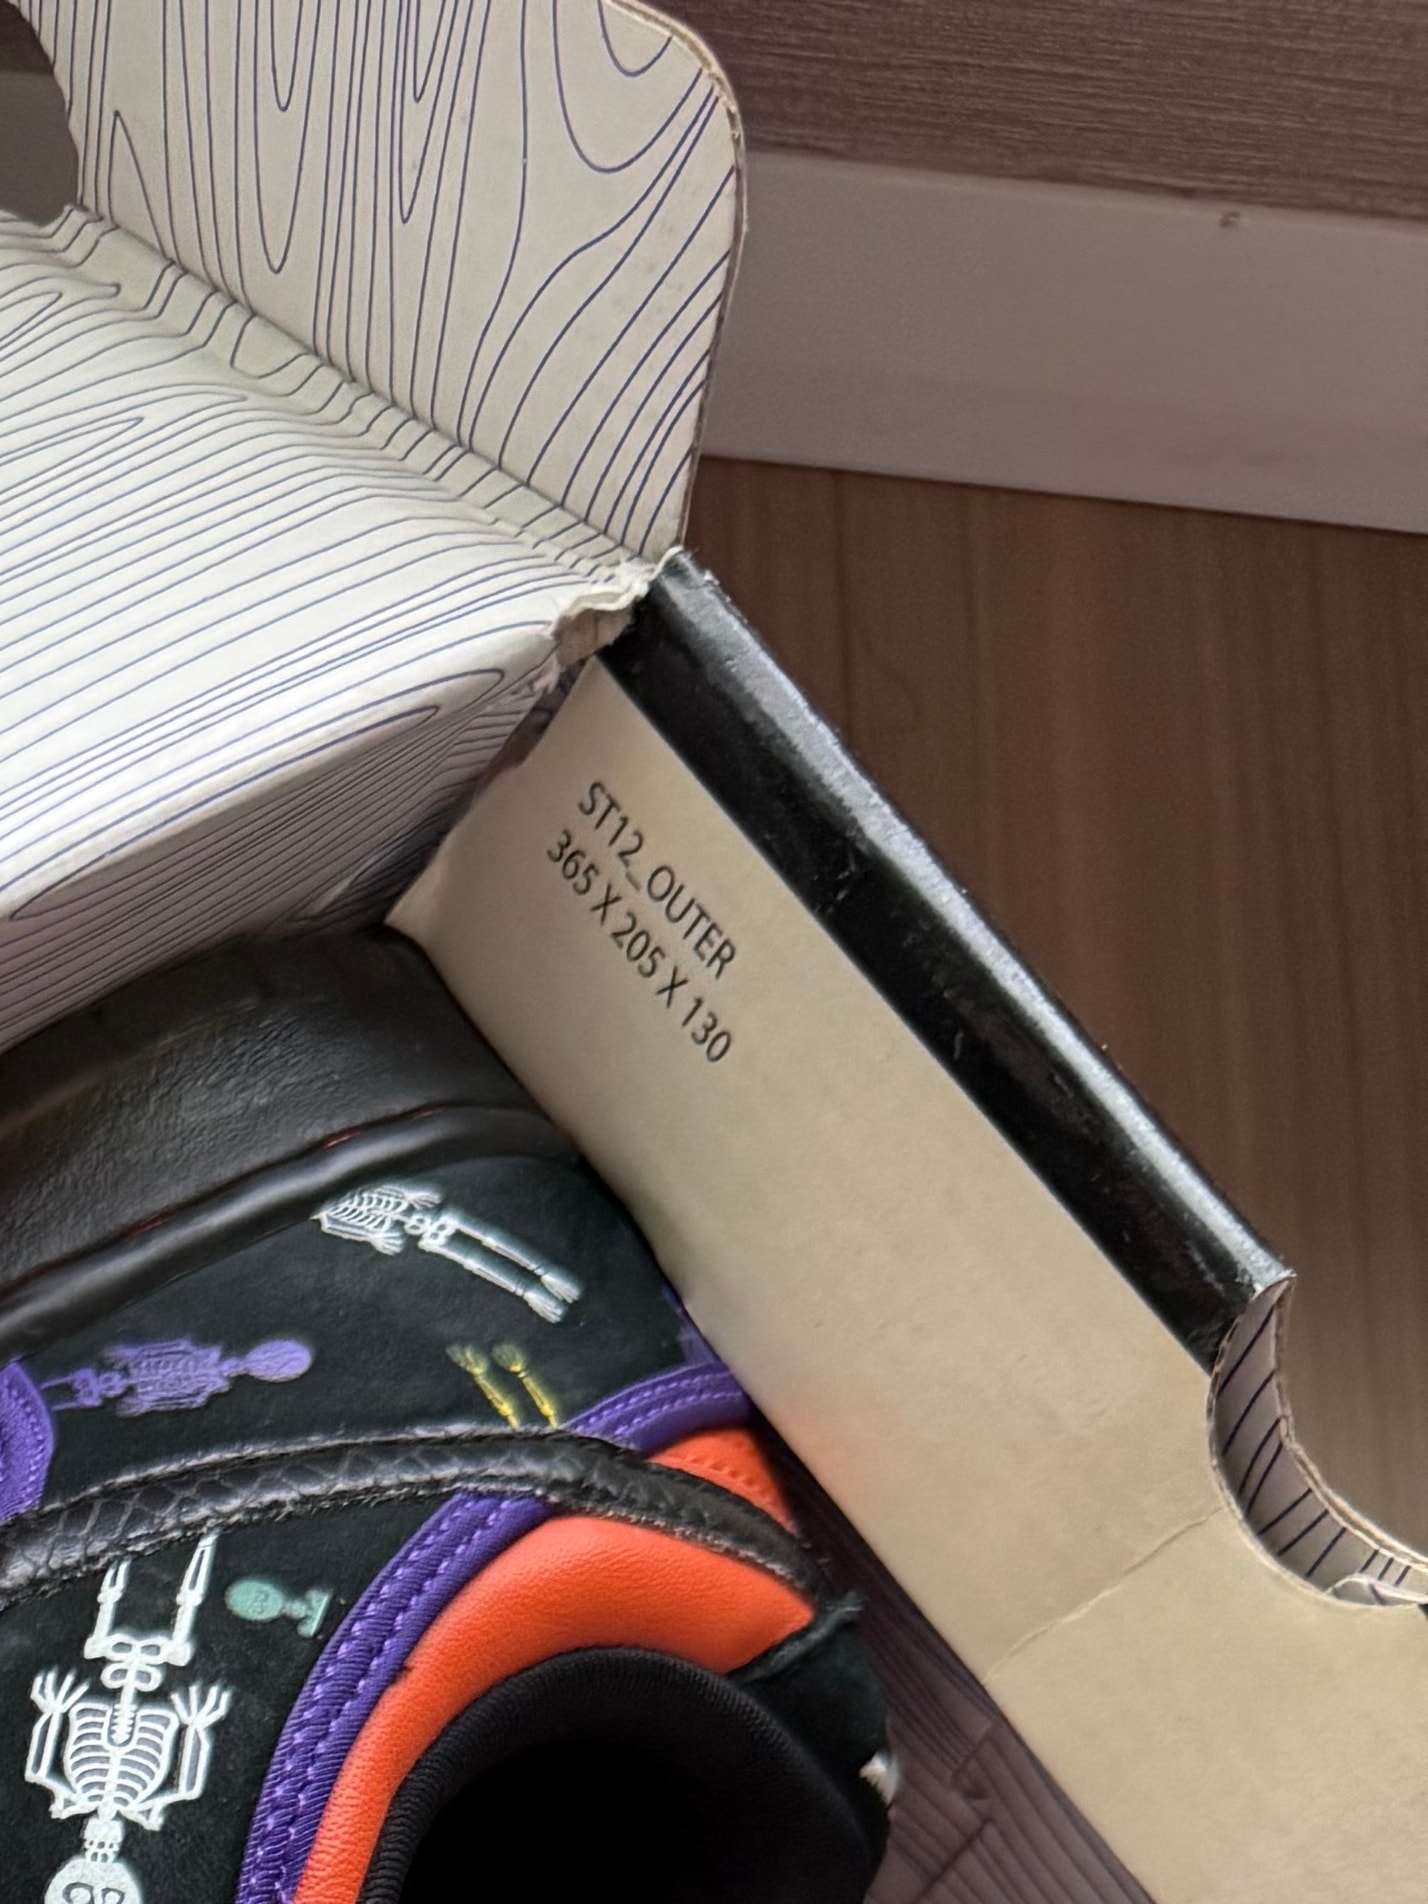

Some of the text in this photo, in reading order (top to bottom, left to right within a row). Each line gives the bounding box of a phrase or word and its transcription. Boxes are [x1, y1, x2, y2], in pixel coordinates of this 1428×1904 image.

[546, 829, 732, 1063] 365 X 205 X 130
[578, 781, 737, 980] ST12_OUTER
